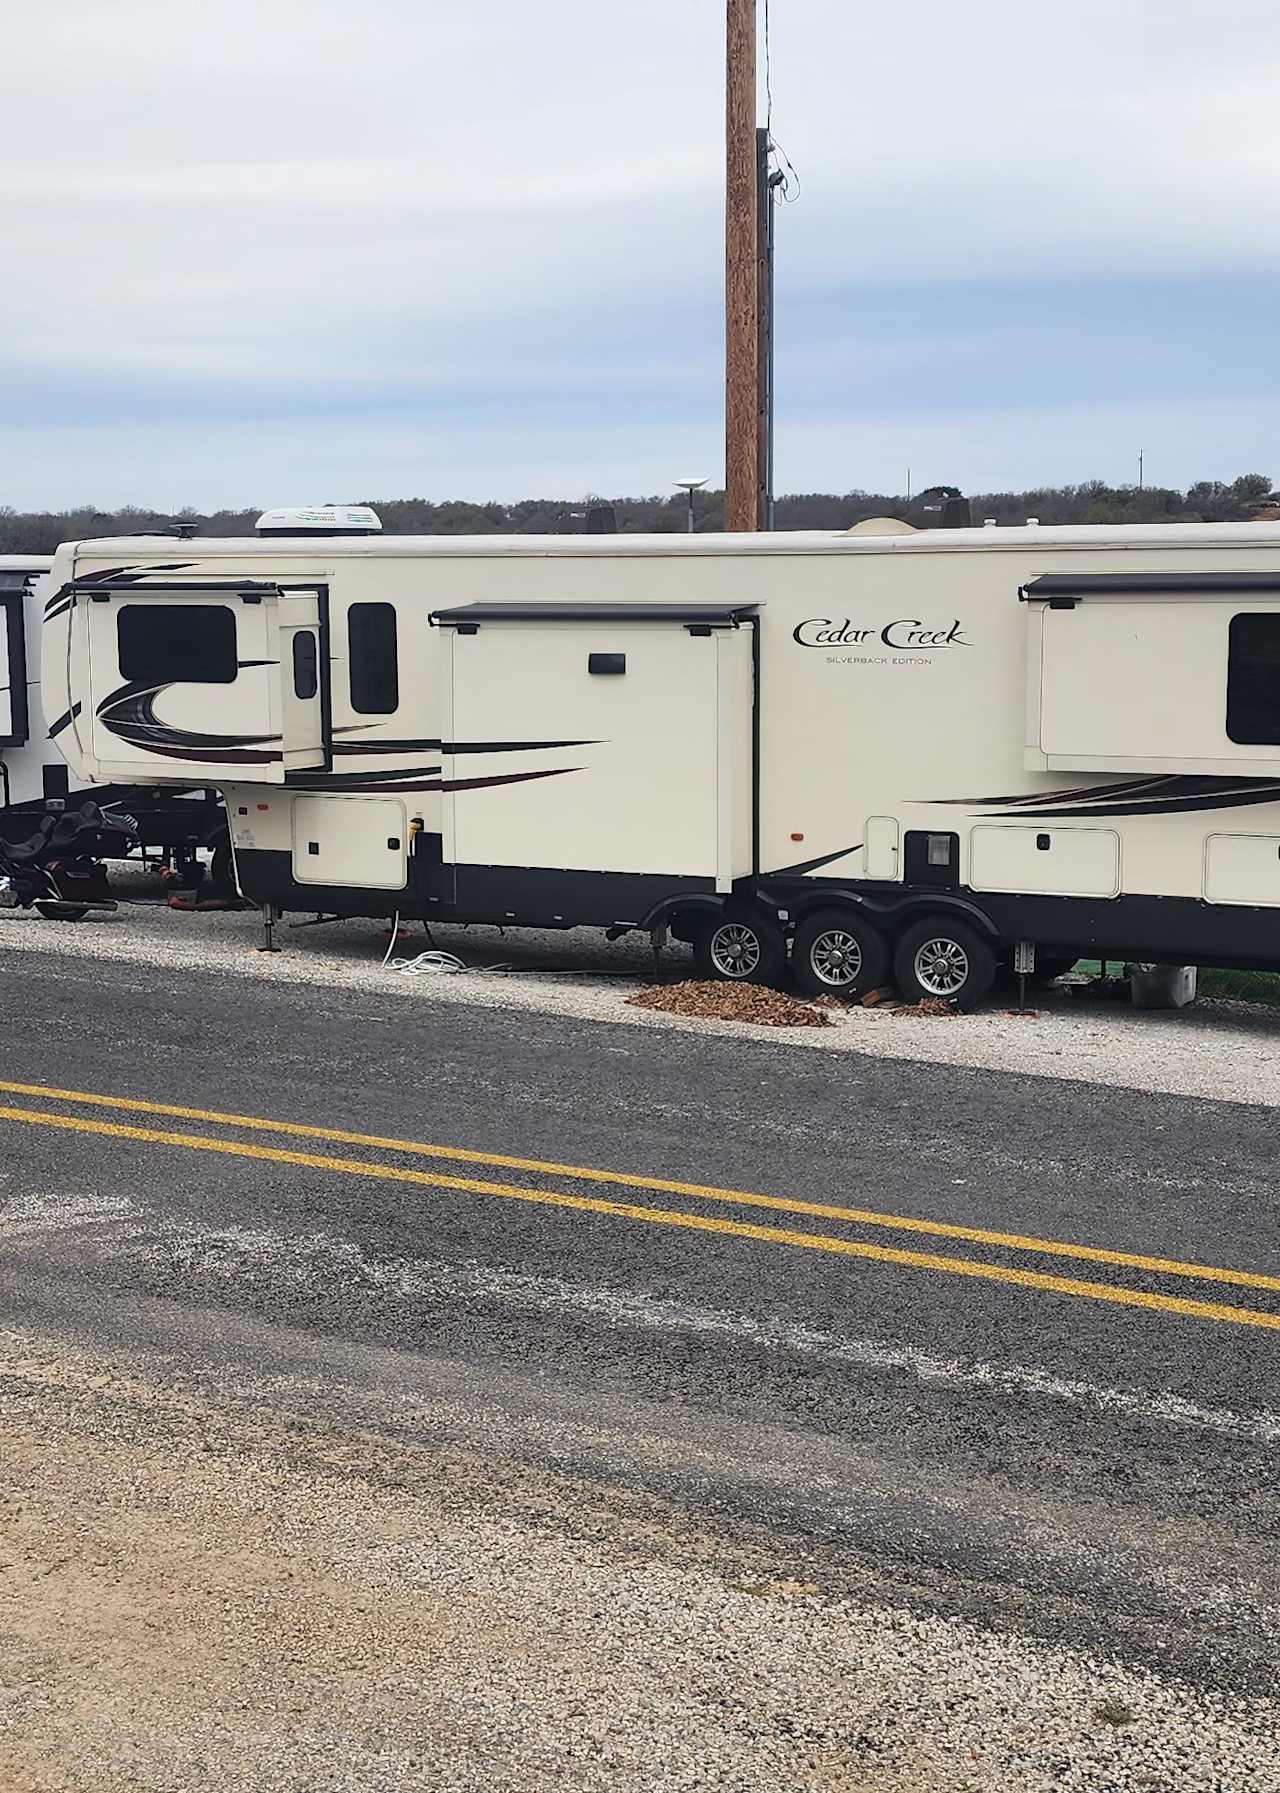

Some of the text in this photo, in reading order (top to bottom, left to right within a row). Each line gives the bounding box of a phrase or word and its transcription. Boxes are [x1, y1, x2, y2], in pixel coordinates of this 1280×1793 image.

[792, 617, 976, 650] Cedar Creek
[826, 656, 933, 666] SILVERBACK EDITION
